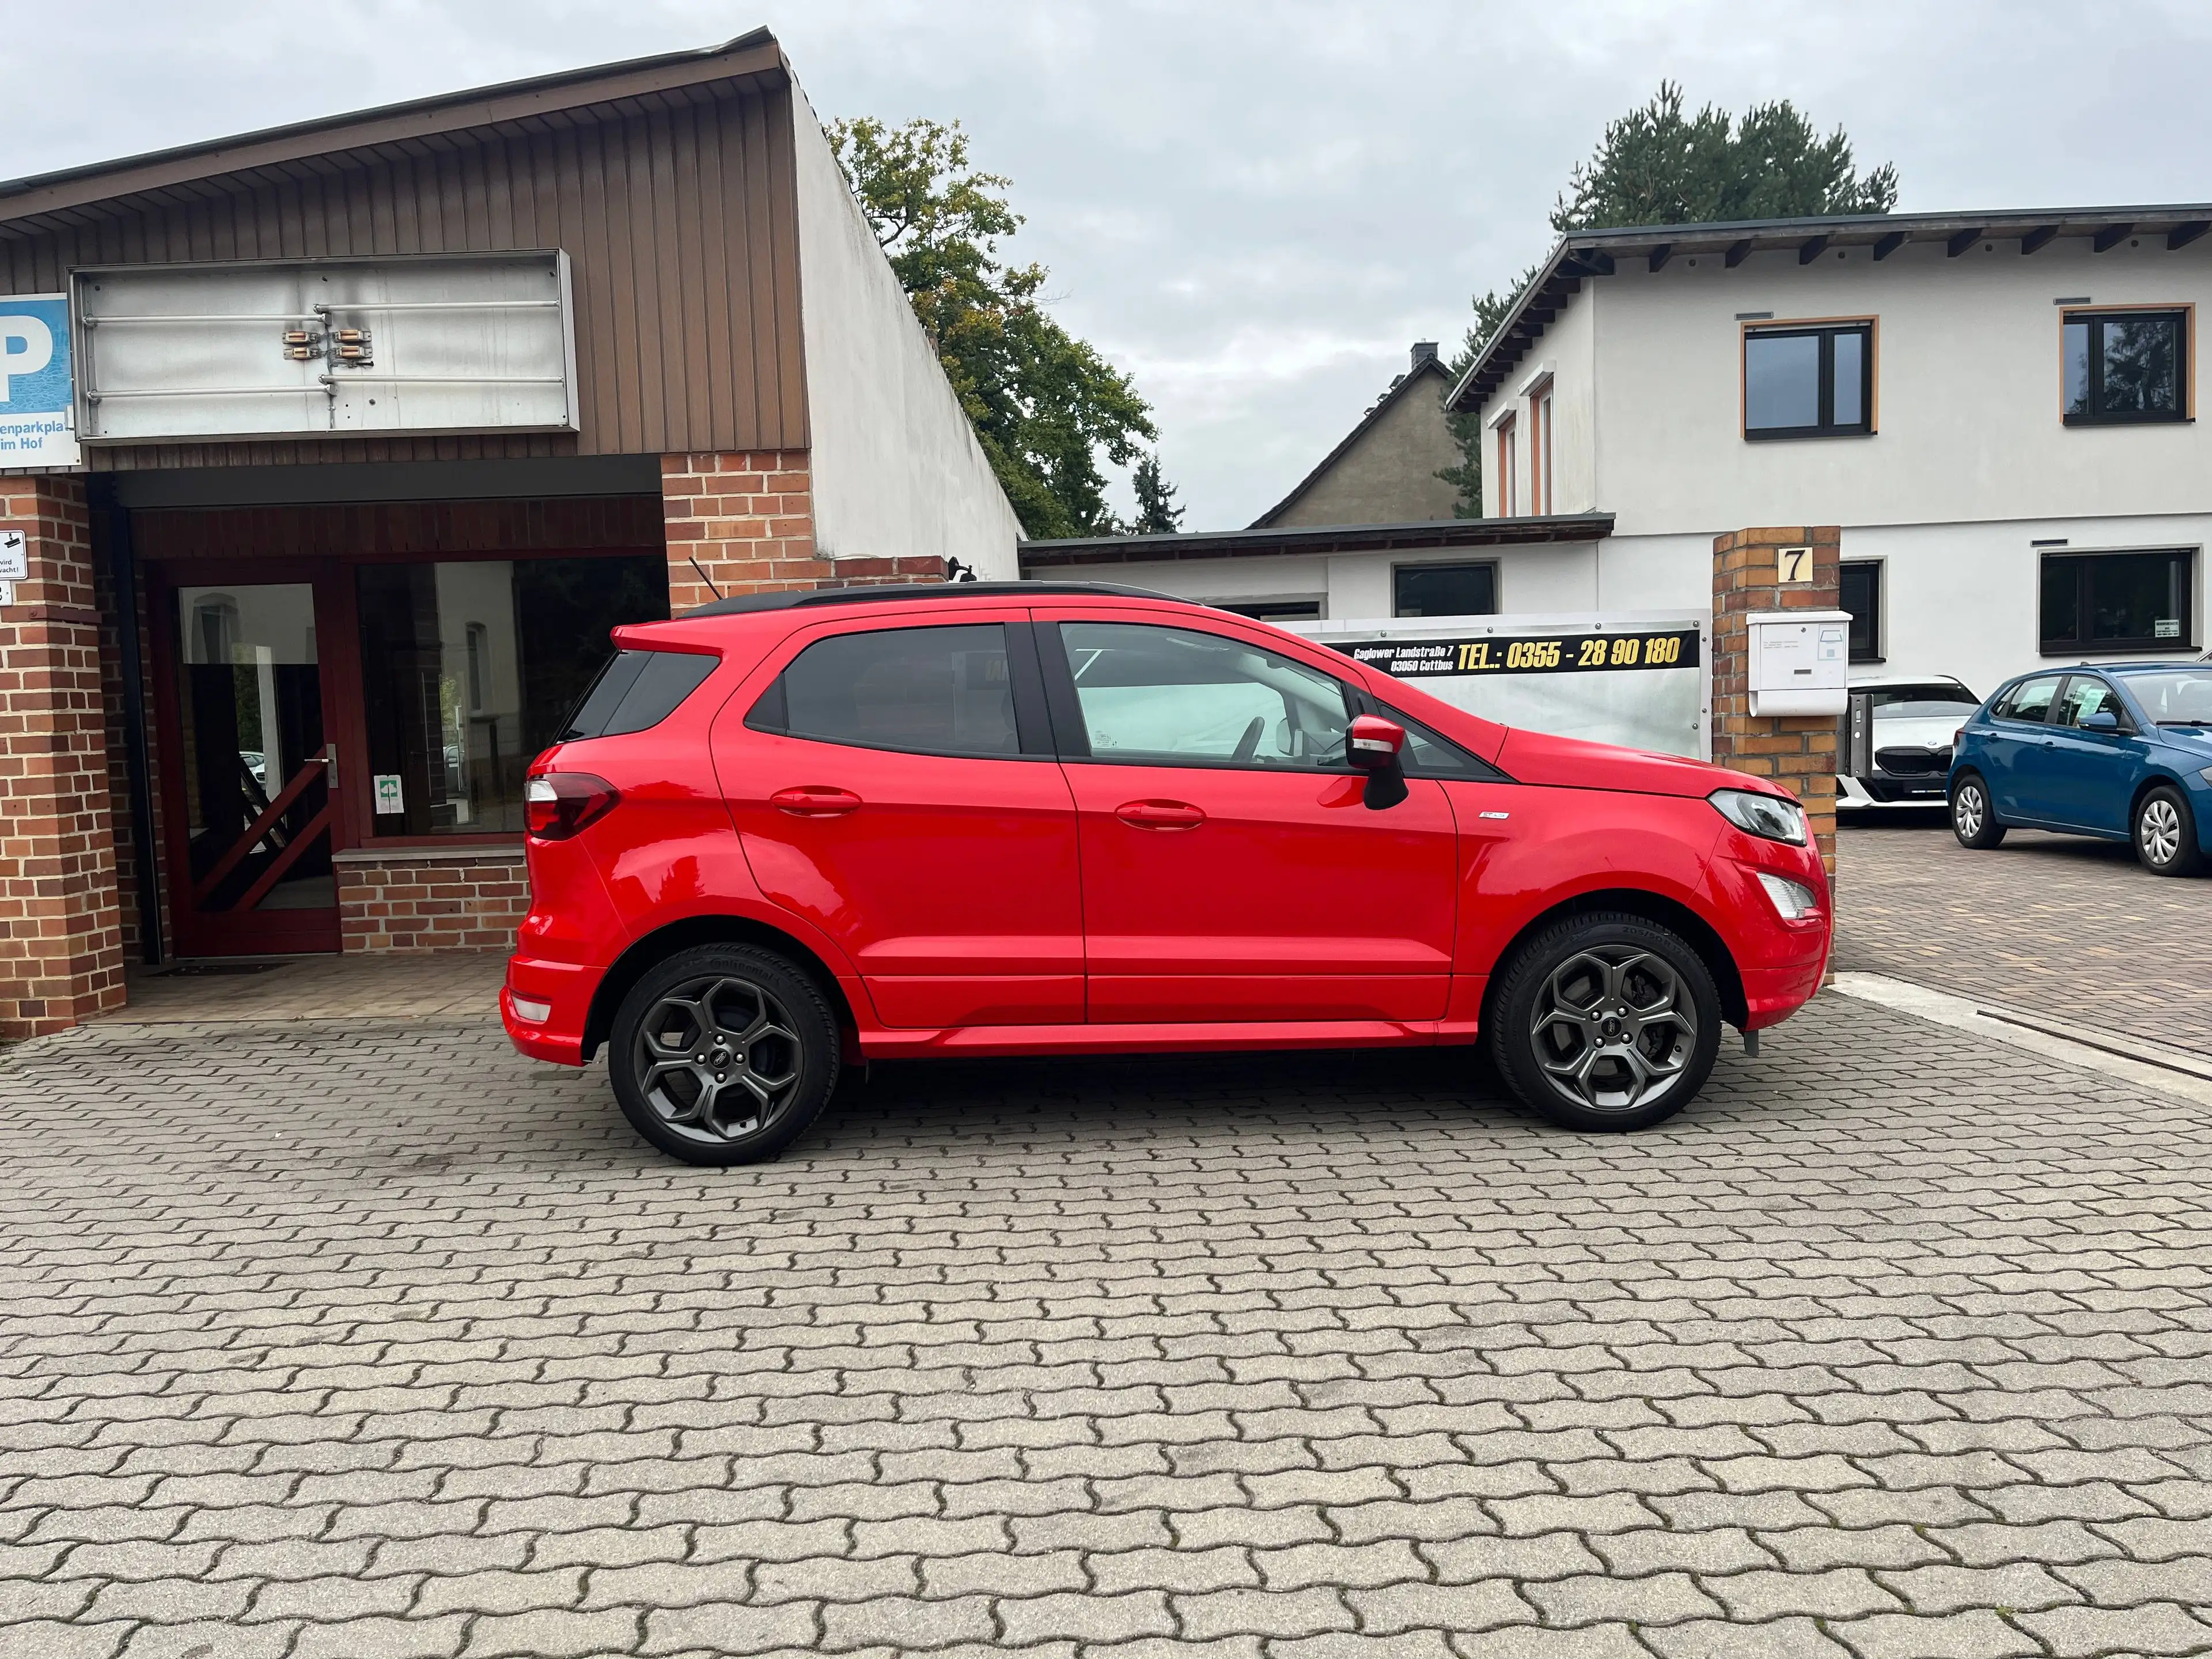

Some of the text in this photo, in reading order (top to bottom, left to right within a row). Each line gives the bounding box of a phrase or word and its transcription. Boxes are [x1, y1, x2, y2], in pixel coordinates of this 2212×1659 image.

[0, 315, 53, 403] P
[0, 421, 67, 437] enparkpla
[1, 437, 43, 449] im Hof
[1785, 550, 1806, 581] 7
[1354, 645, 1455, 661] Gaglower Landstraße 7
[1458, 643, 1503, 670] TEL.:
[1506, 641, 1562, 668] 0355
[1578, 639, 1608, 666] 28
[1611, 639, 1640, 665] 90
[1645, 637, 1681, 664] 180
[1391, 660, 1454, 672] 03050 Cottbus
[710, 958, 774, 980] Continental
